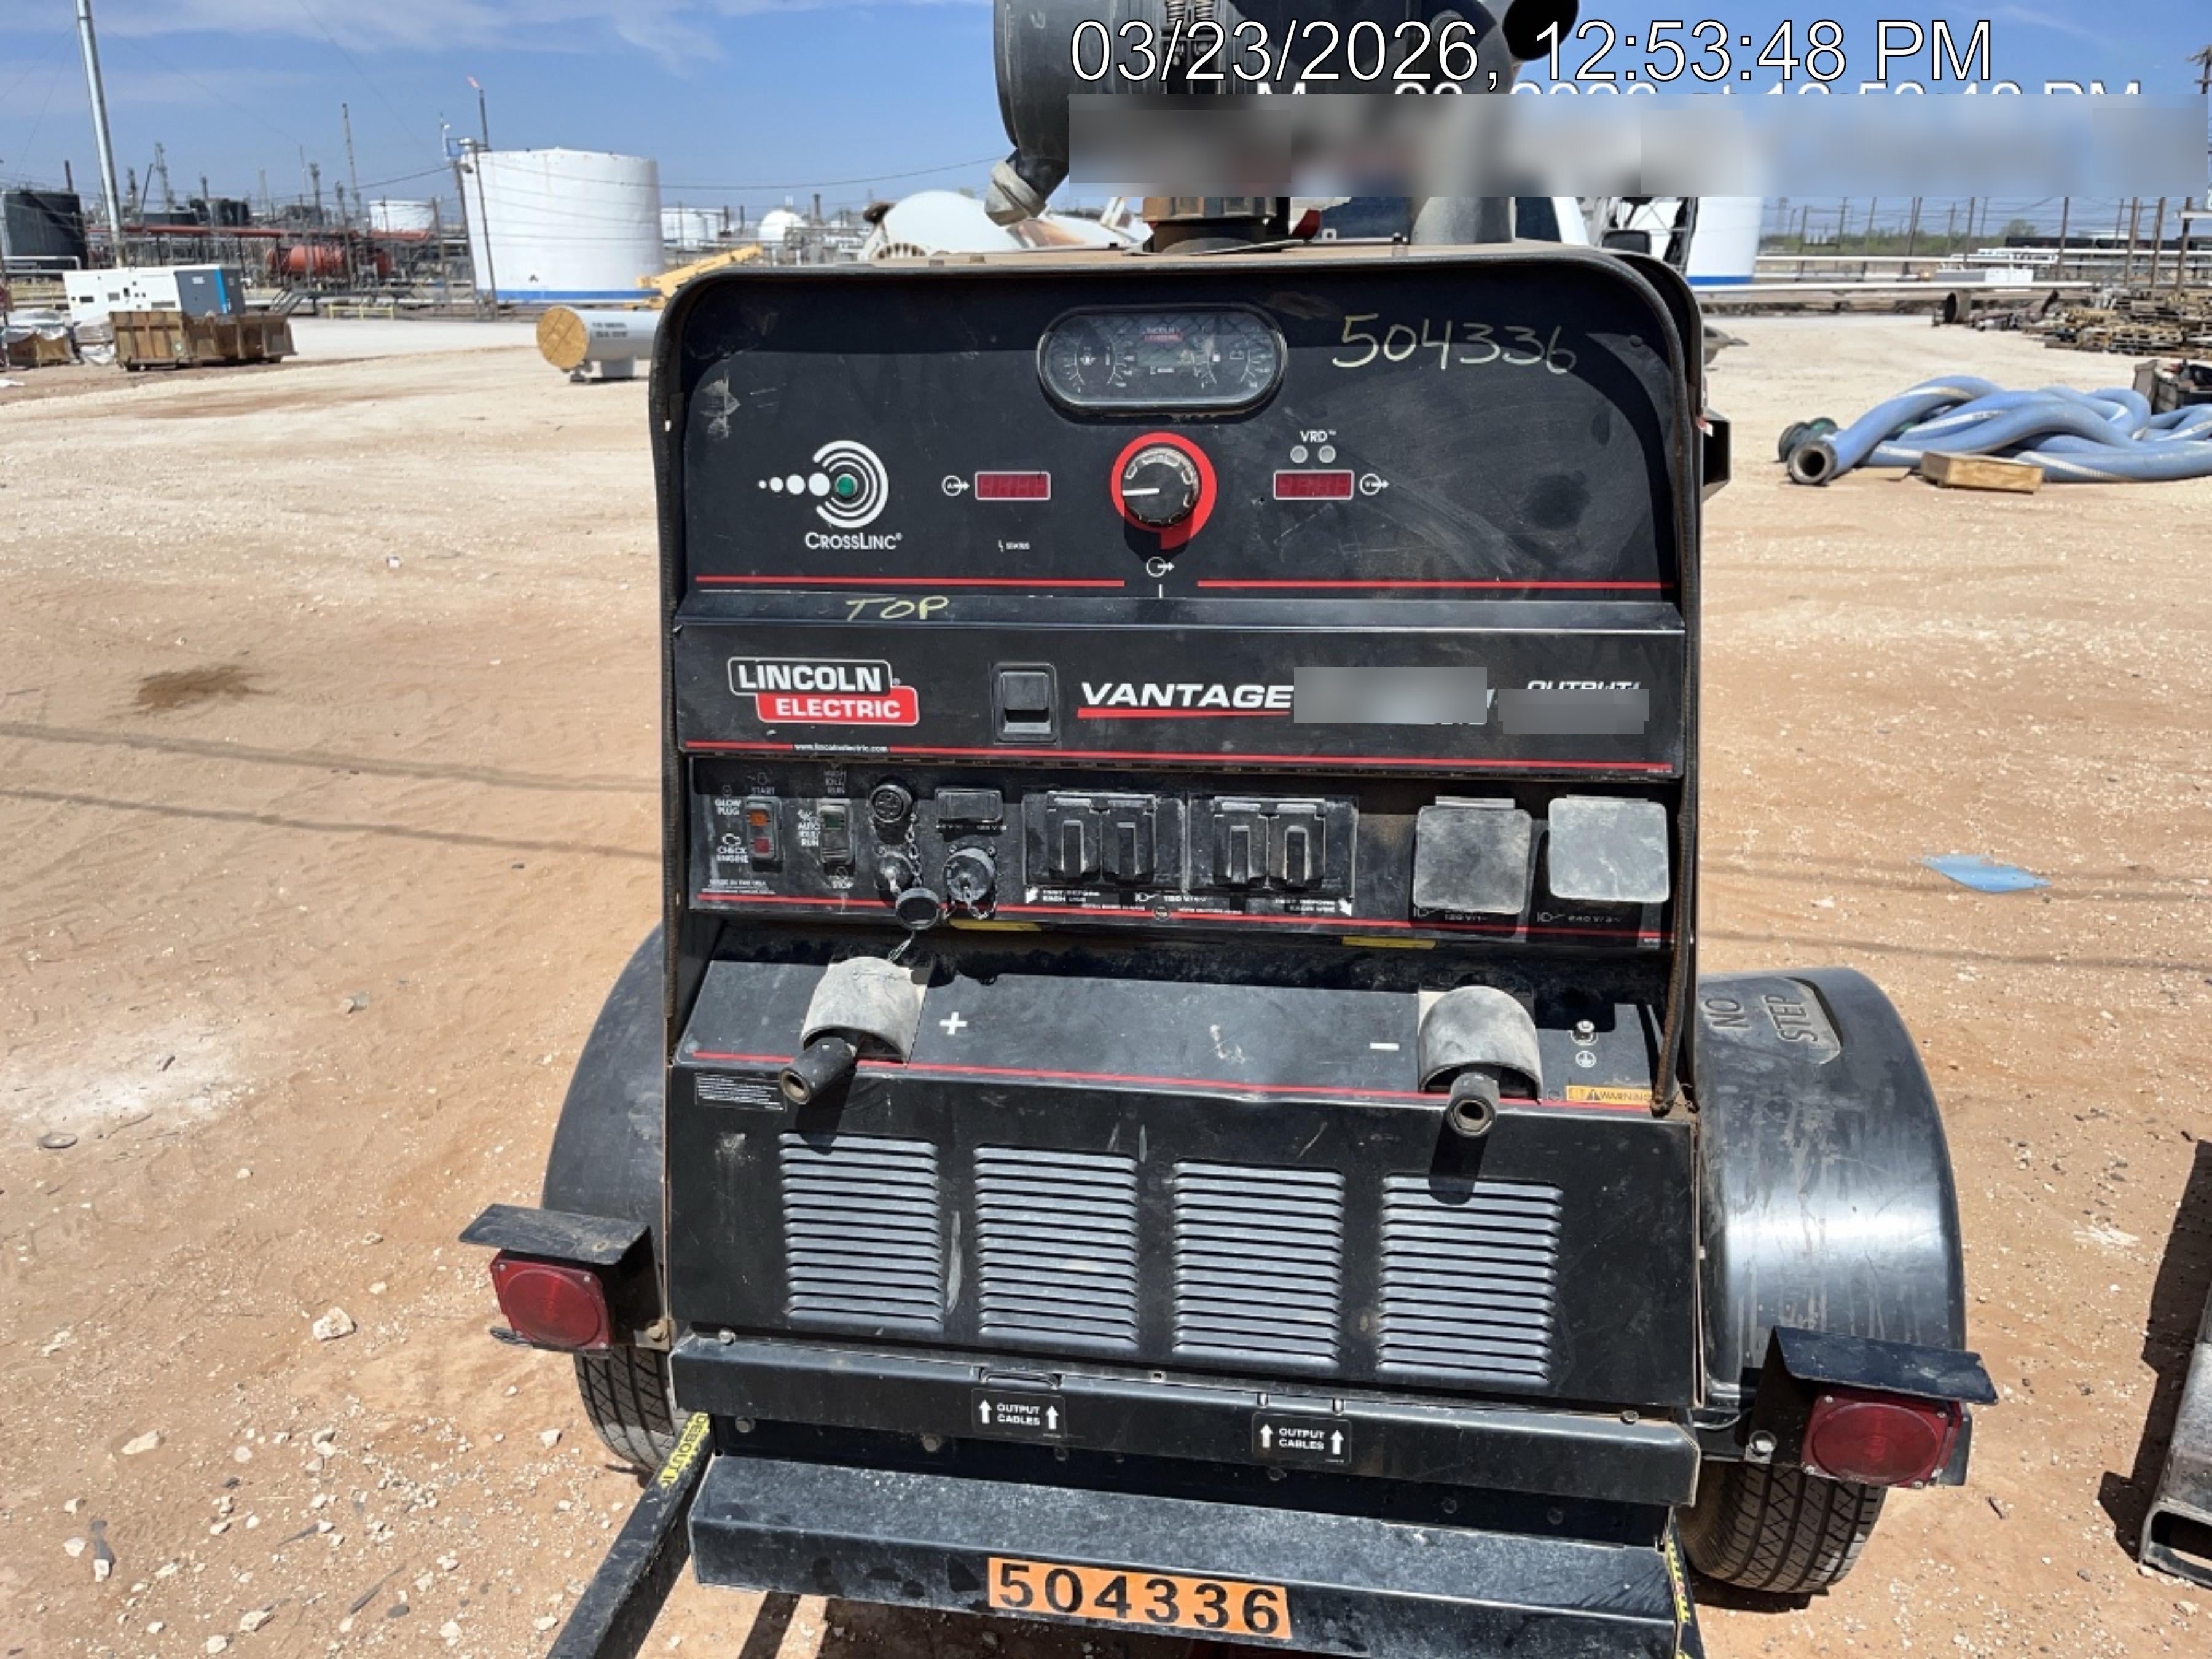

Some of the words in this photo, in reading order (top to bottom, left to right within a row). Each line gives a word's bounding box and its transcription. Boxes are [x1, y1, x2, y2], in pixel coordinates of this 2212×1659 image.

[1332, 313, 1577, 374] 504336
[846, 596, 949, 621] TOP
[738, 665, 882, 692] LINCOLN
[1081, 683, 1293, 709] VANTAGE
[775, 698, 901, 720] ELECTRIC
[794, 742, 889, 753] www.lincolnelectric.com
[716, 807, 740, 816] PLUG
[798, 822, 821, 830] AUTO
[801, 837, 820, 847] RUN
[716, 845, 748, 854] CHECK
[716, 854, 749, 863] ENGINE
[1701, 997, 1751, 1030] NO
[1762, 993, 1819, 1043] STEP
[997, 1403, 1041, 1414] OUTPUT
[997, 1414, 1041, 1426] CABLES
[1279, 1427, 1326, 1439] OUTPUT
[1279, 1438, 1325, 1451] CABLES
[998, 1563, 1281, 1634] 504336
